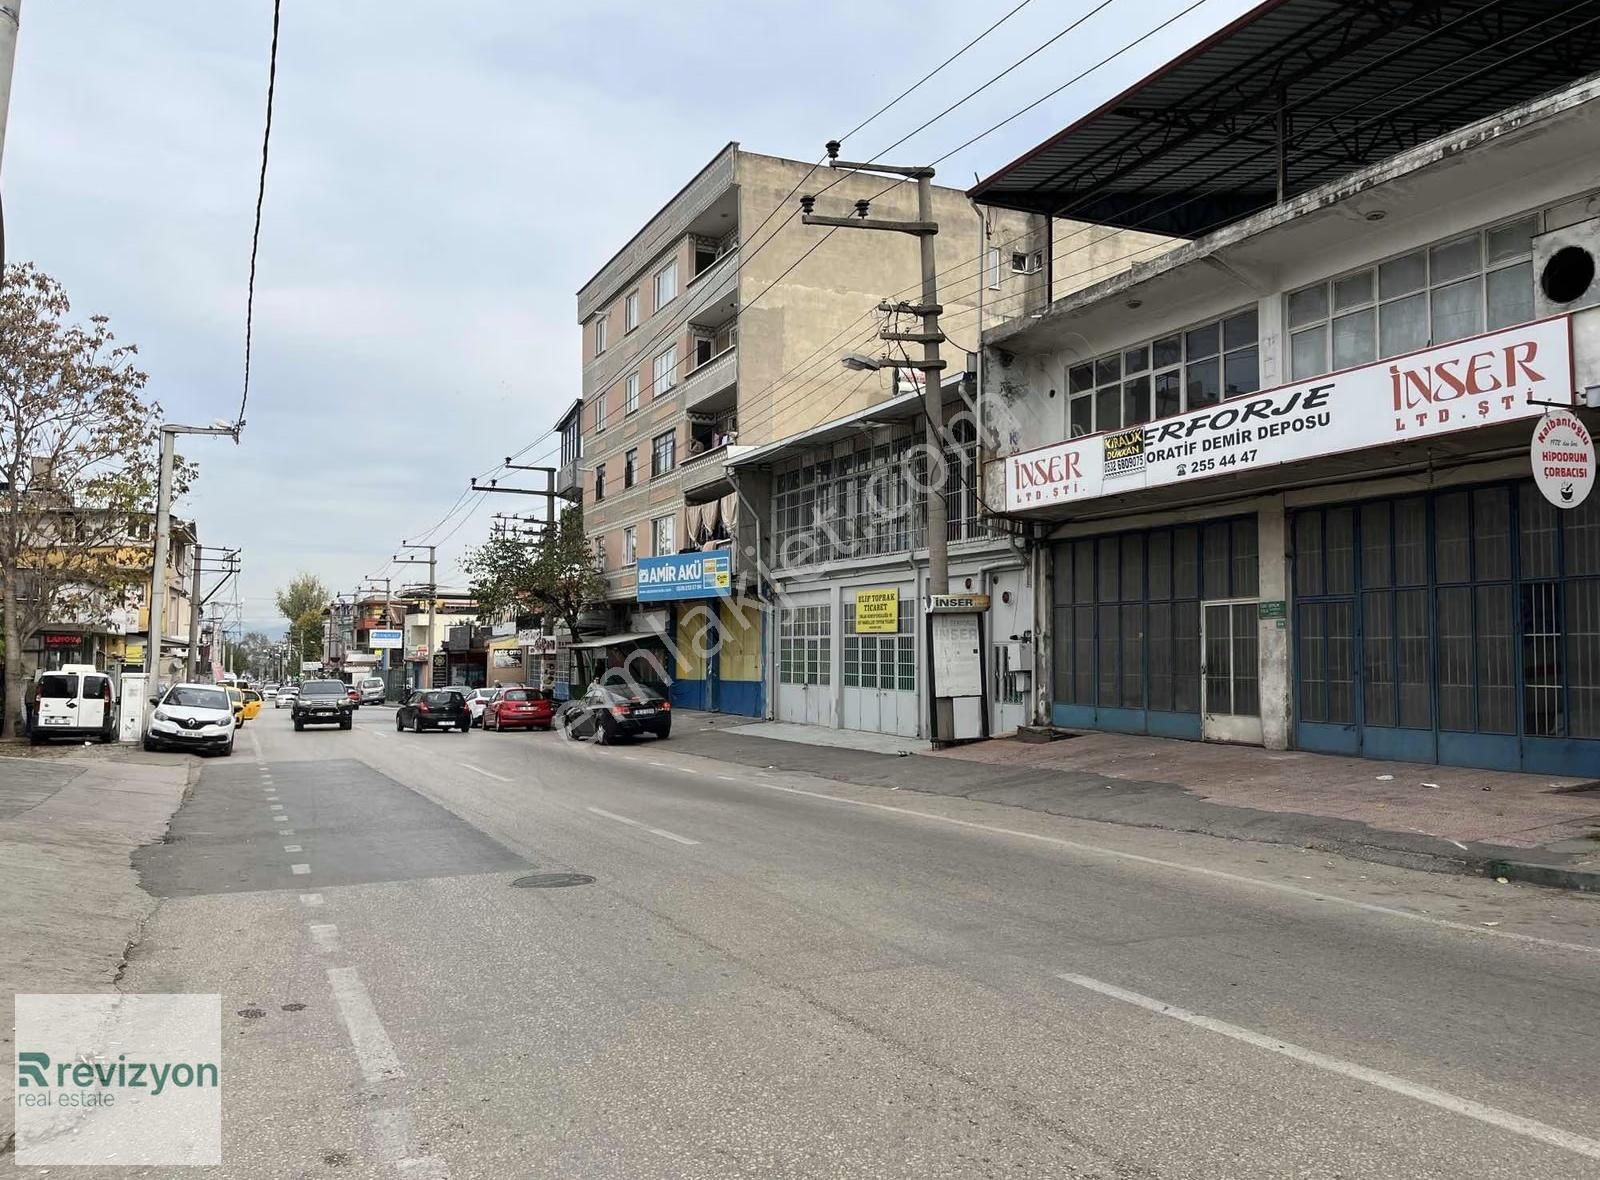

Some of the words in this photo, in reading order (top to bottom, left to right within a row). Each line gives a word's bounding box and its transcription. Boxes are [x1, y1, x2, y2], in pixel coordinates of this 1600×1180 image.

[1389, 342, 1546, 411] İNSER
[1203, 428, 1252, 451] DEMİR
[1257, 412, 1330, 439] DEPOSU
[1014, 452, 1083, 489] İNSER
[1191, 460, 1215, 474] 255
[1219, 455, 1236, 467] 44
[1240, 449, 1257, 463] 47
[649, 563, 676, 583] AMİR
[678, 560, 702, 580] AKÜ
